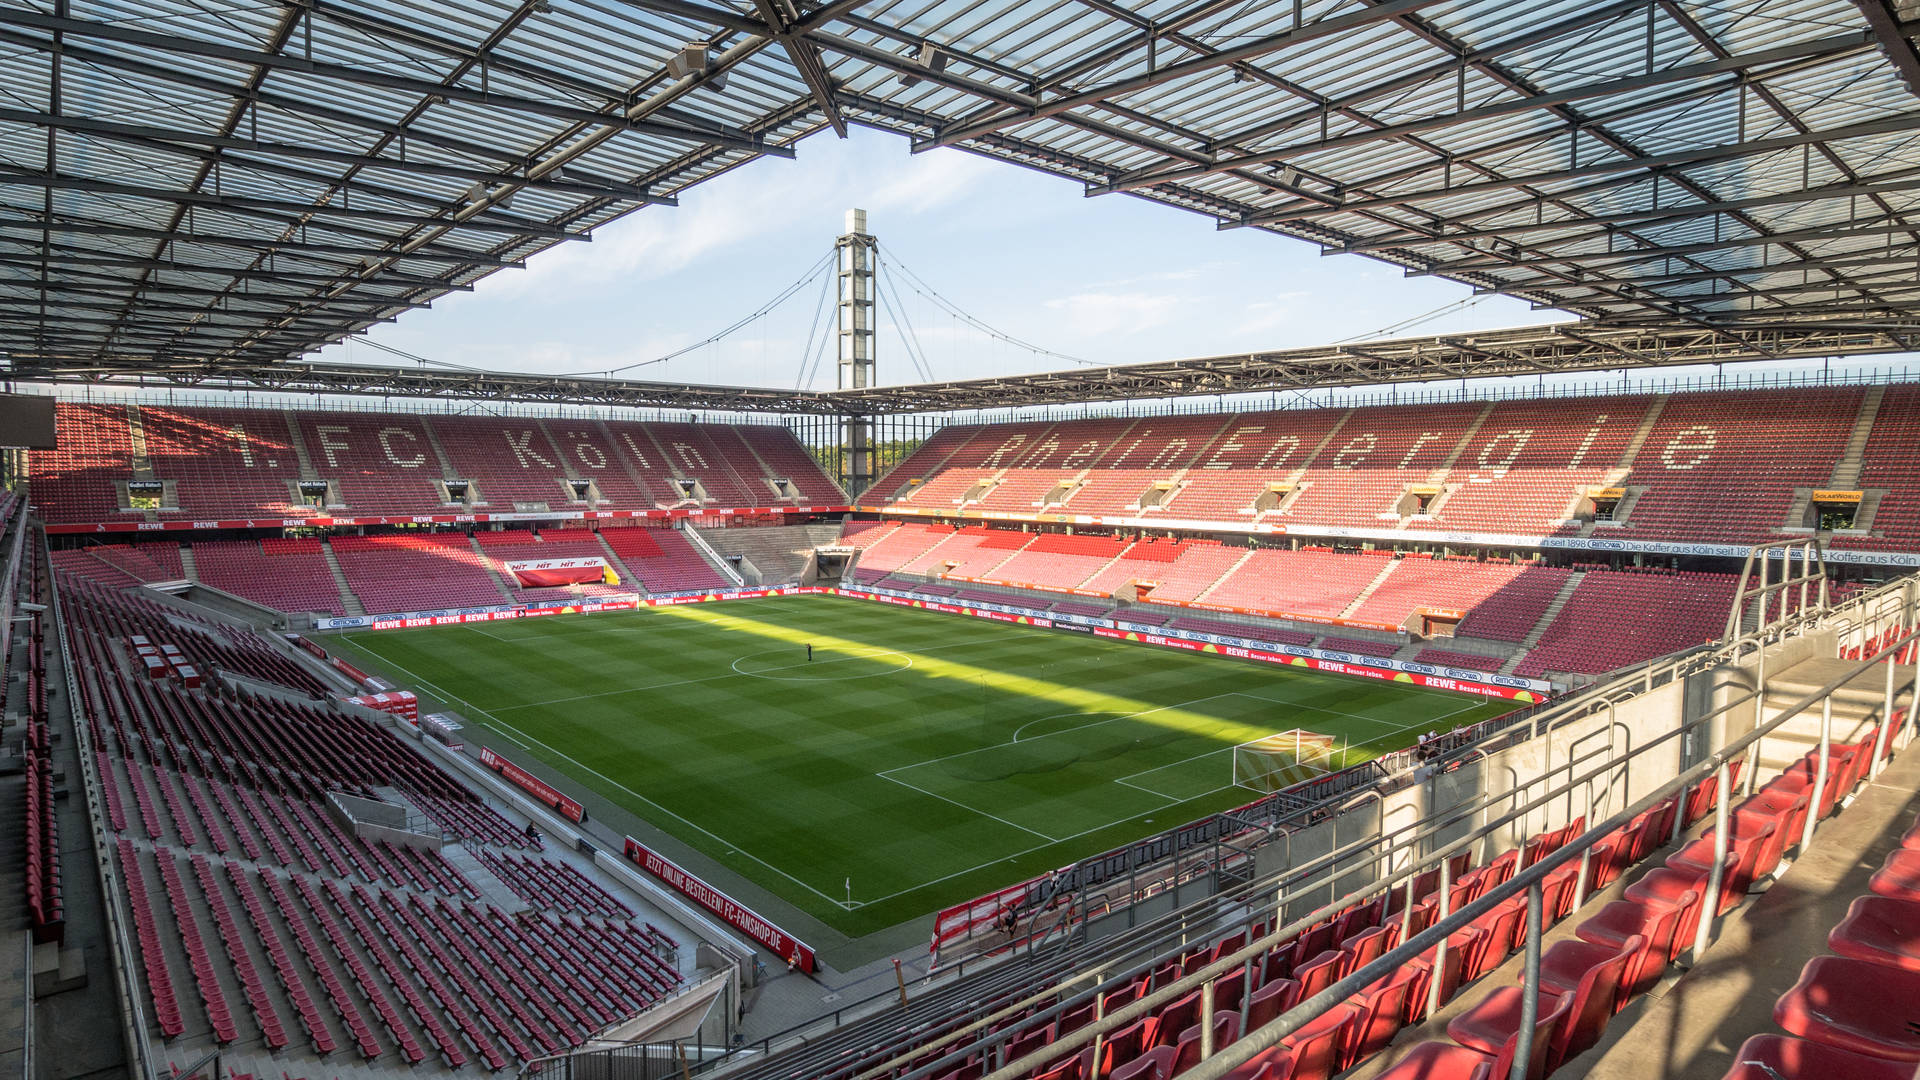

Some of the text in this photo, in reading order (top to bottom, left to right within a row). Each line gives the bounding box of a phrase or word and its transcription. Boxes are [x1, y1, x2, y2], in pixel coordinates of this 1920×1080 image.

[316, 426, 426, 468] FC
[503, 430, 709, 469] Köln
[193, 521, 219, 529] REWE
[1551, 538, 1565, 546] seit
[1567, 539, 1586, 548] 1898
[1591, 541, 1621, 549] RIMOWA
[1626, 542, 1641, 550] Die
[1643, 543, 1670, 552] Koffer
[1692, 545, 1714, 555] Köln
[1716, 547, 1735, 556] seit
[1809, 550, 1917, 565] De Koffer aus Köln
[582, 603, 602, 611] REWE
[655, 598, 674, 606] REWE
[465, 613, 489, 621] REWE
[494, 611, 517, 619] REWE
[977, 609, 991, 618] REWE
[375, 621, 400, 629] REWE
[406, 618, 431, 627] REWE
[436, 616, 460, 624] REWE
[1033, 618, 1050, 627] REWE
[1146, 635, 1166, 645] REWE
[1252, 642, 1275, 650] RIMOWA
[1226, 647, 1249, 658] REWE
[1251, 653, 1266, 661] Besser
[1287, 647, 1311, 656] RIMOWA
[1324, 651, 1349, 662] RIMOWA
[1363, 657, 1389, 667] RIMOWA
[1318, 661, 1385, 679] REWE Besser leben.
[1404, 663, 1432, 673] RIMOWA
[1448, 669, 1478, 681] RIMOWA
[1425, 676, 1503, 697] REWE Besser leben.
[1495, 676, 1527, 687] RIMOWA
[646, 853, 781, 951] JETZT ONLINE BESTELLEN! FC-FANSHOP.DE
